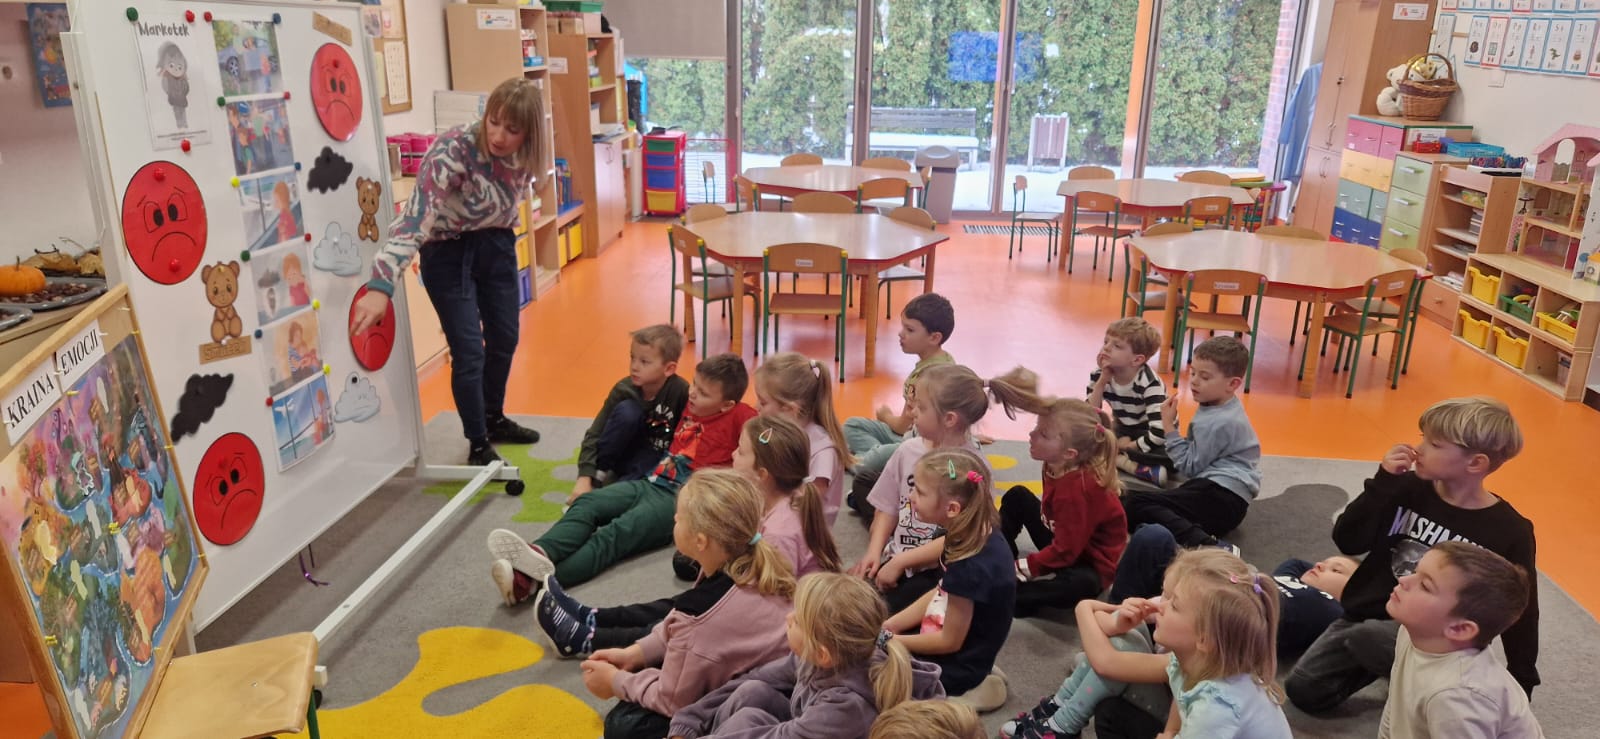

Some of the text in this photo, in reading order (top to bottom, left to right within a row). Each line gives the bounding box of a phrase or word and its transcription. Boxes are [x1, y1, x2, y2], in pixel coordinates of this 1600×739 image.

[138, 21, 190, 37] Markotek
[7, 329, 99, 428] KRAINA EMOCJI
[655, 403, 674, 420] AIR
